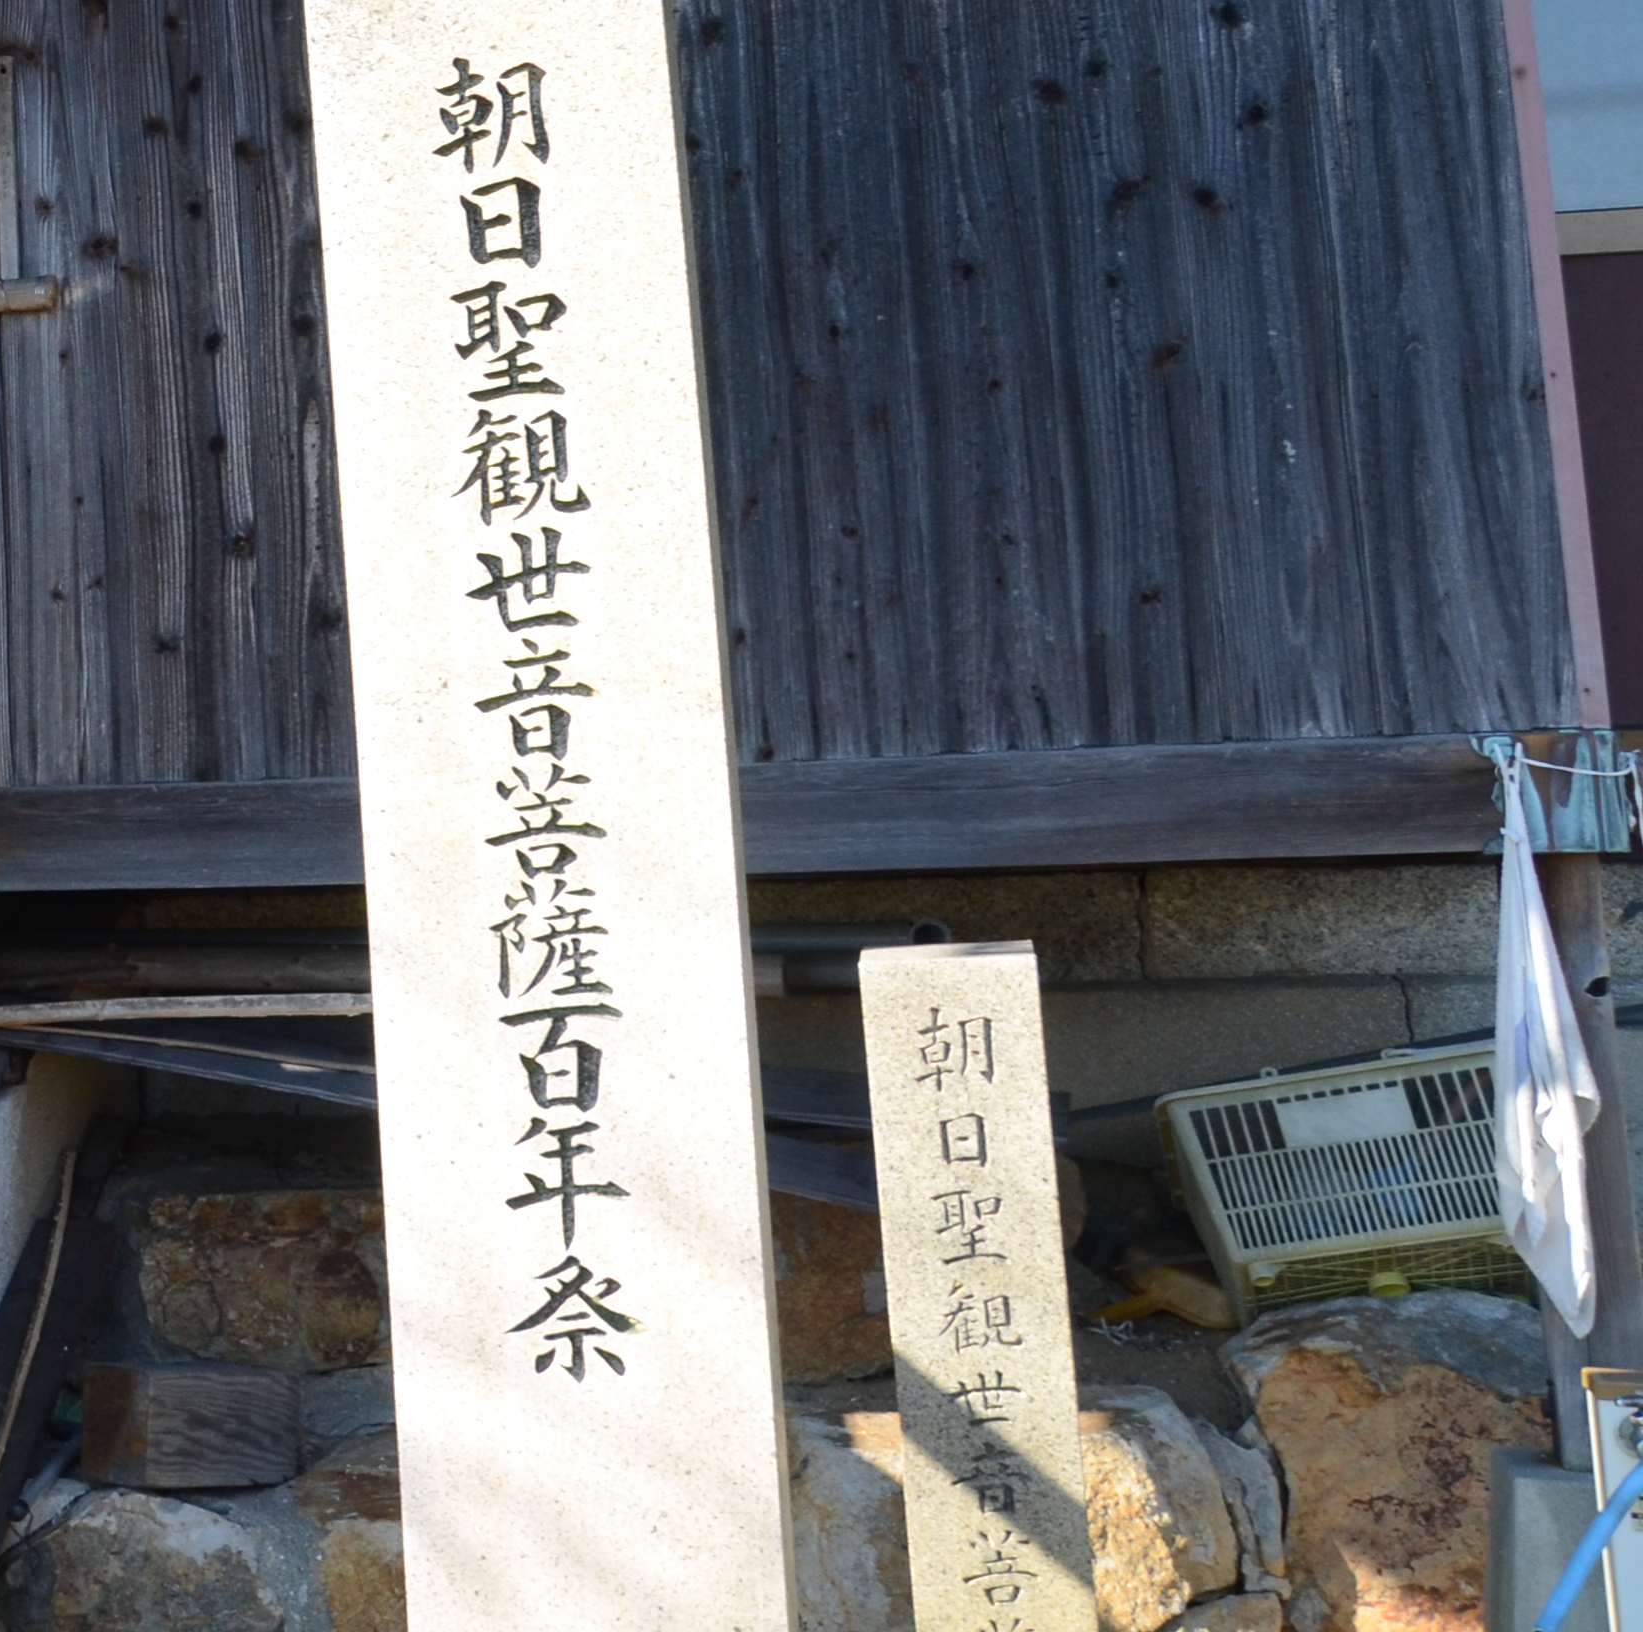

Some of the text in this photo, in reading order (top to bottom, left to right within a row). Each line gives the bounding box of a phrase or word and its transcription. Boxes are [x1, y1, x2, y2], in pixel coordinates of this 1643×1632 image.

[432, 57, 643, 1383] 朝日聖観世音菩薩百年祭
[913, 1007, 1043, 1632] 朝日聖観世音菩
